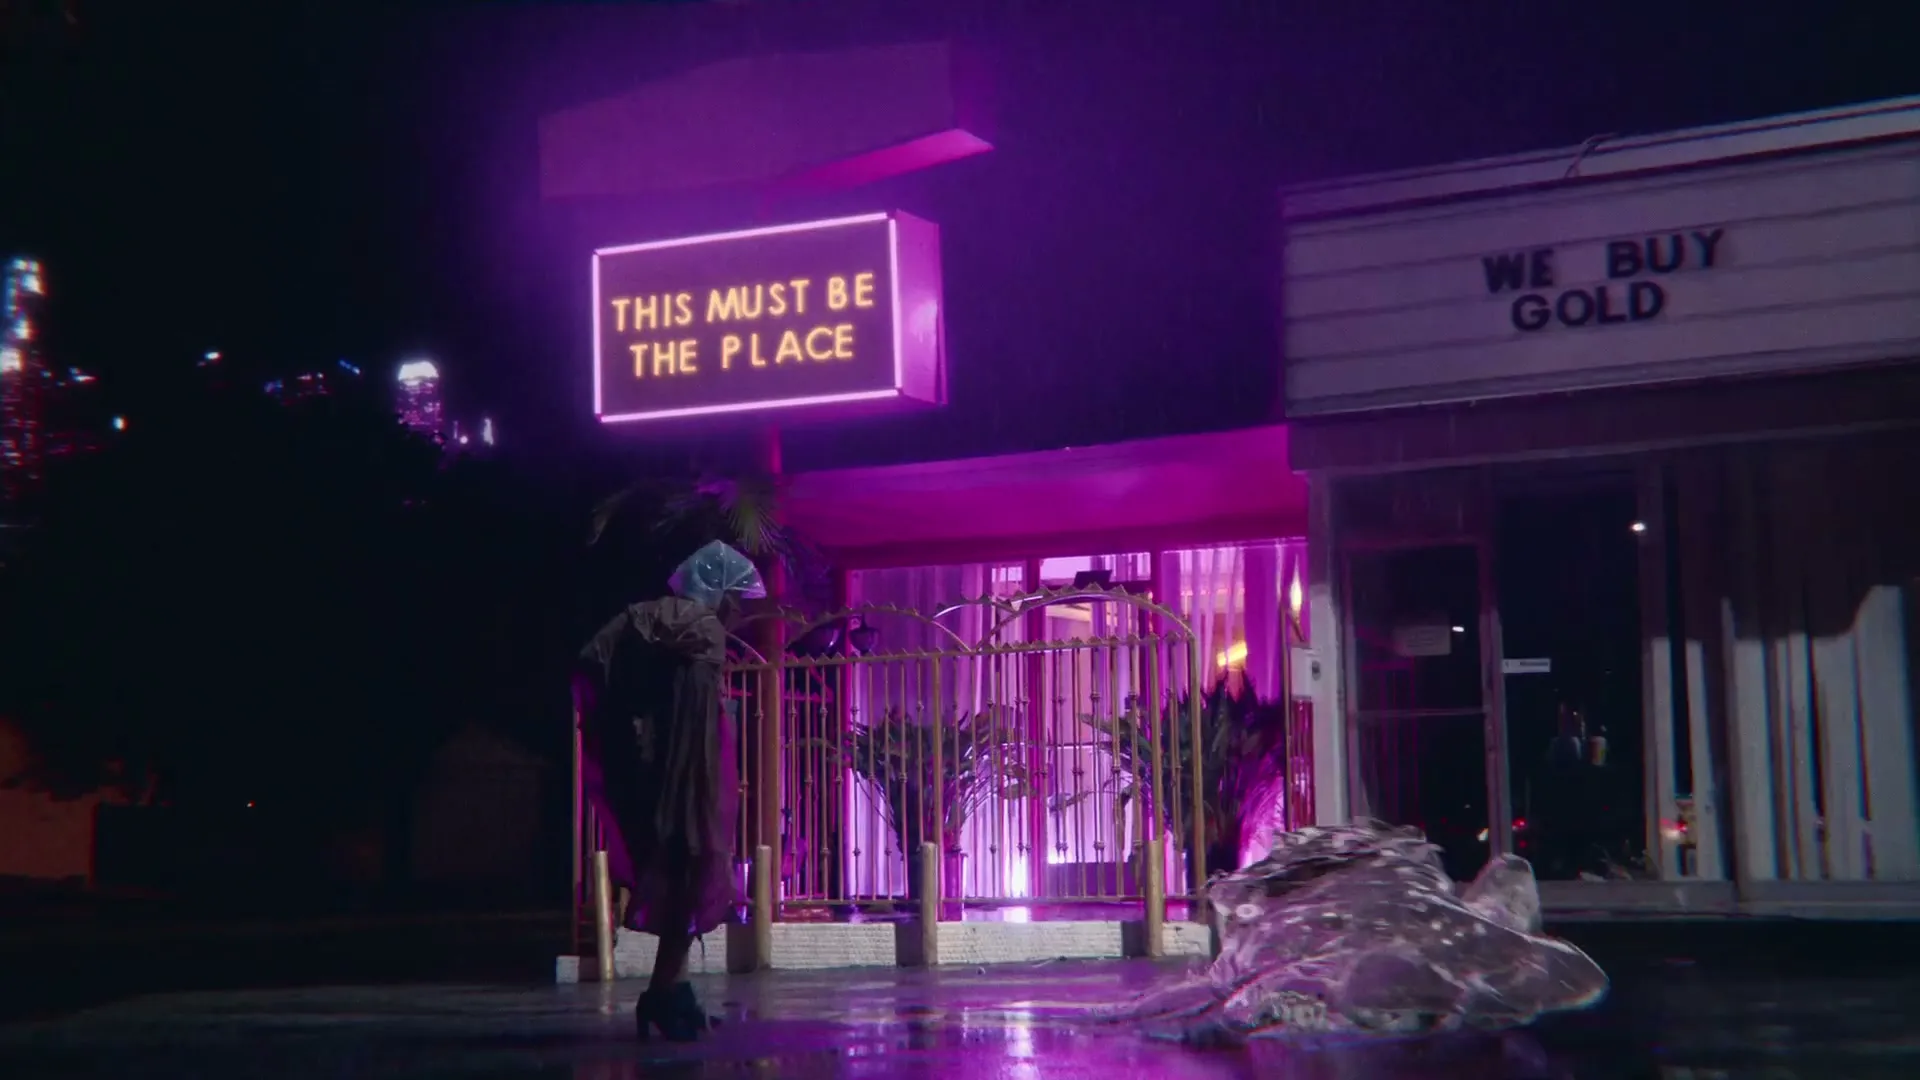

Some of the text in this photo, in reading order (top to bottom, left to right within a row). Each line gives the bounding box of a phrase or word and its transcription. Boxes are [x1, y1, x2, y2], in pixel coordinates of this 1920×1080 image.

[1482, 228, 1724, 294] WE BUY
[612, 272, 874, 332] THIS MUST BE
[1511, 281, 1665, 332] GOLD
[629, 324, 853, 378] THE PLACE
